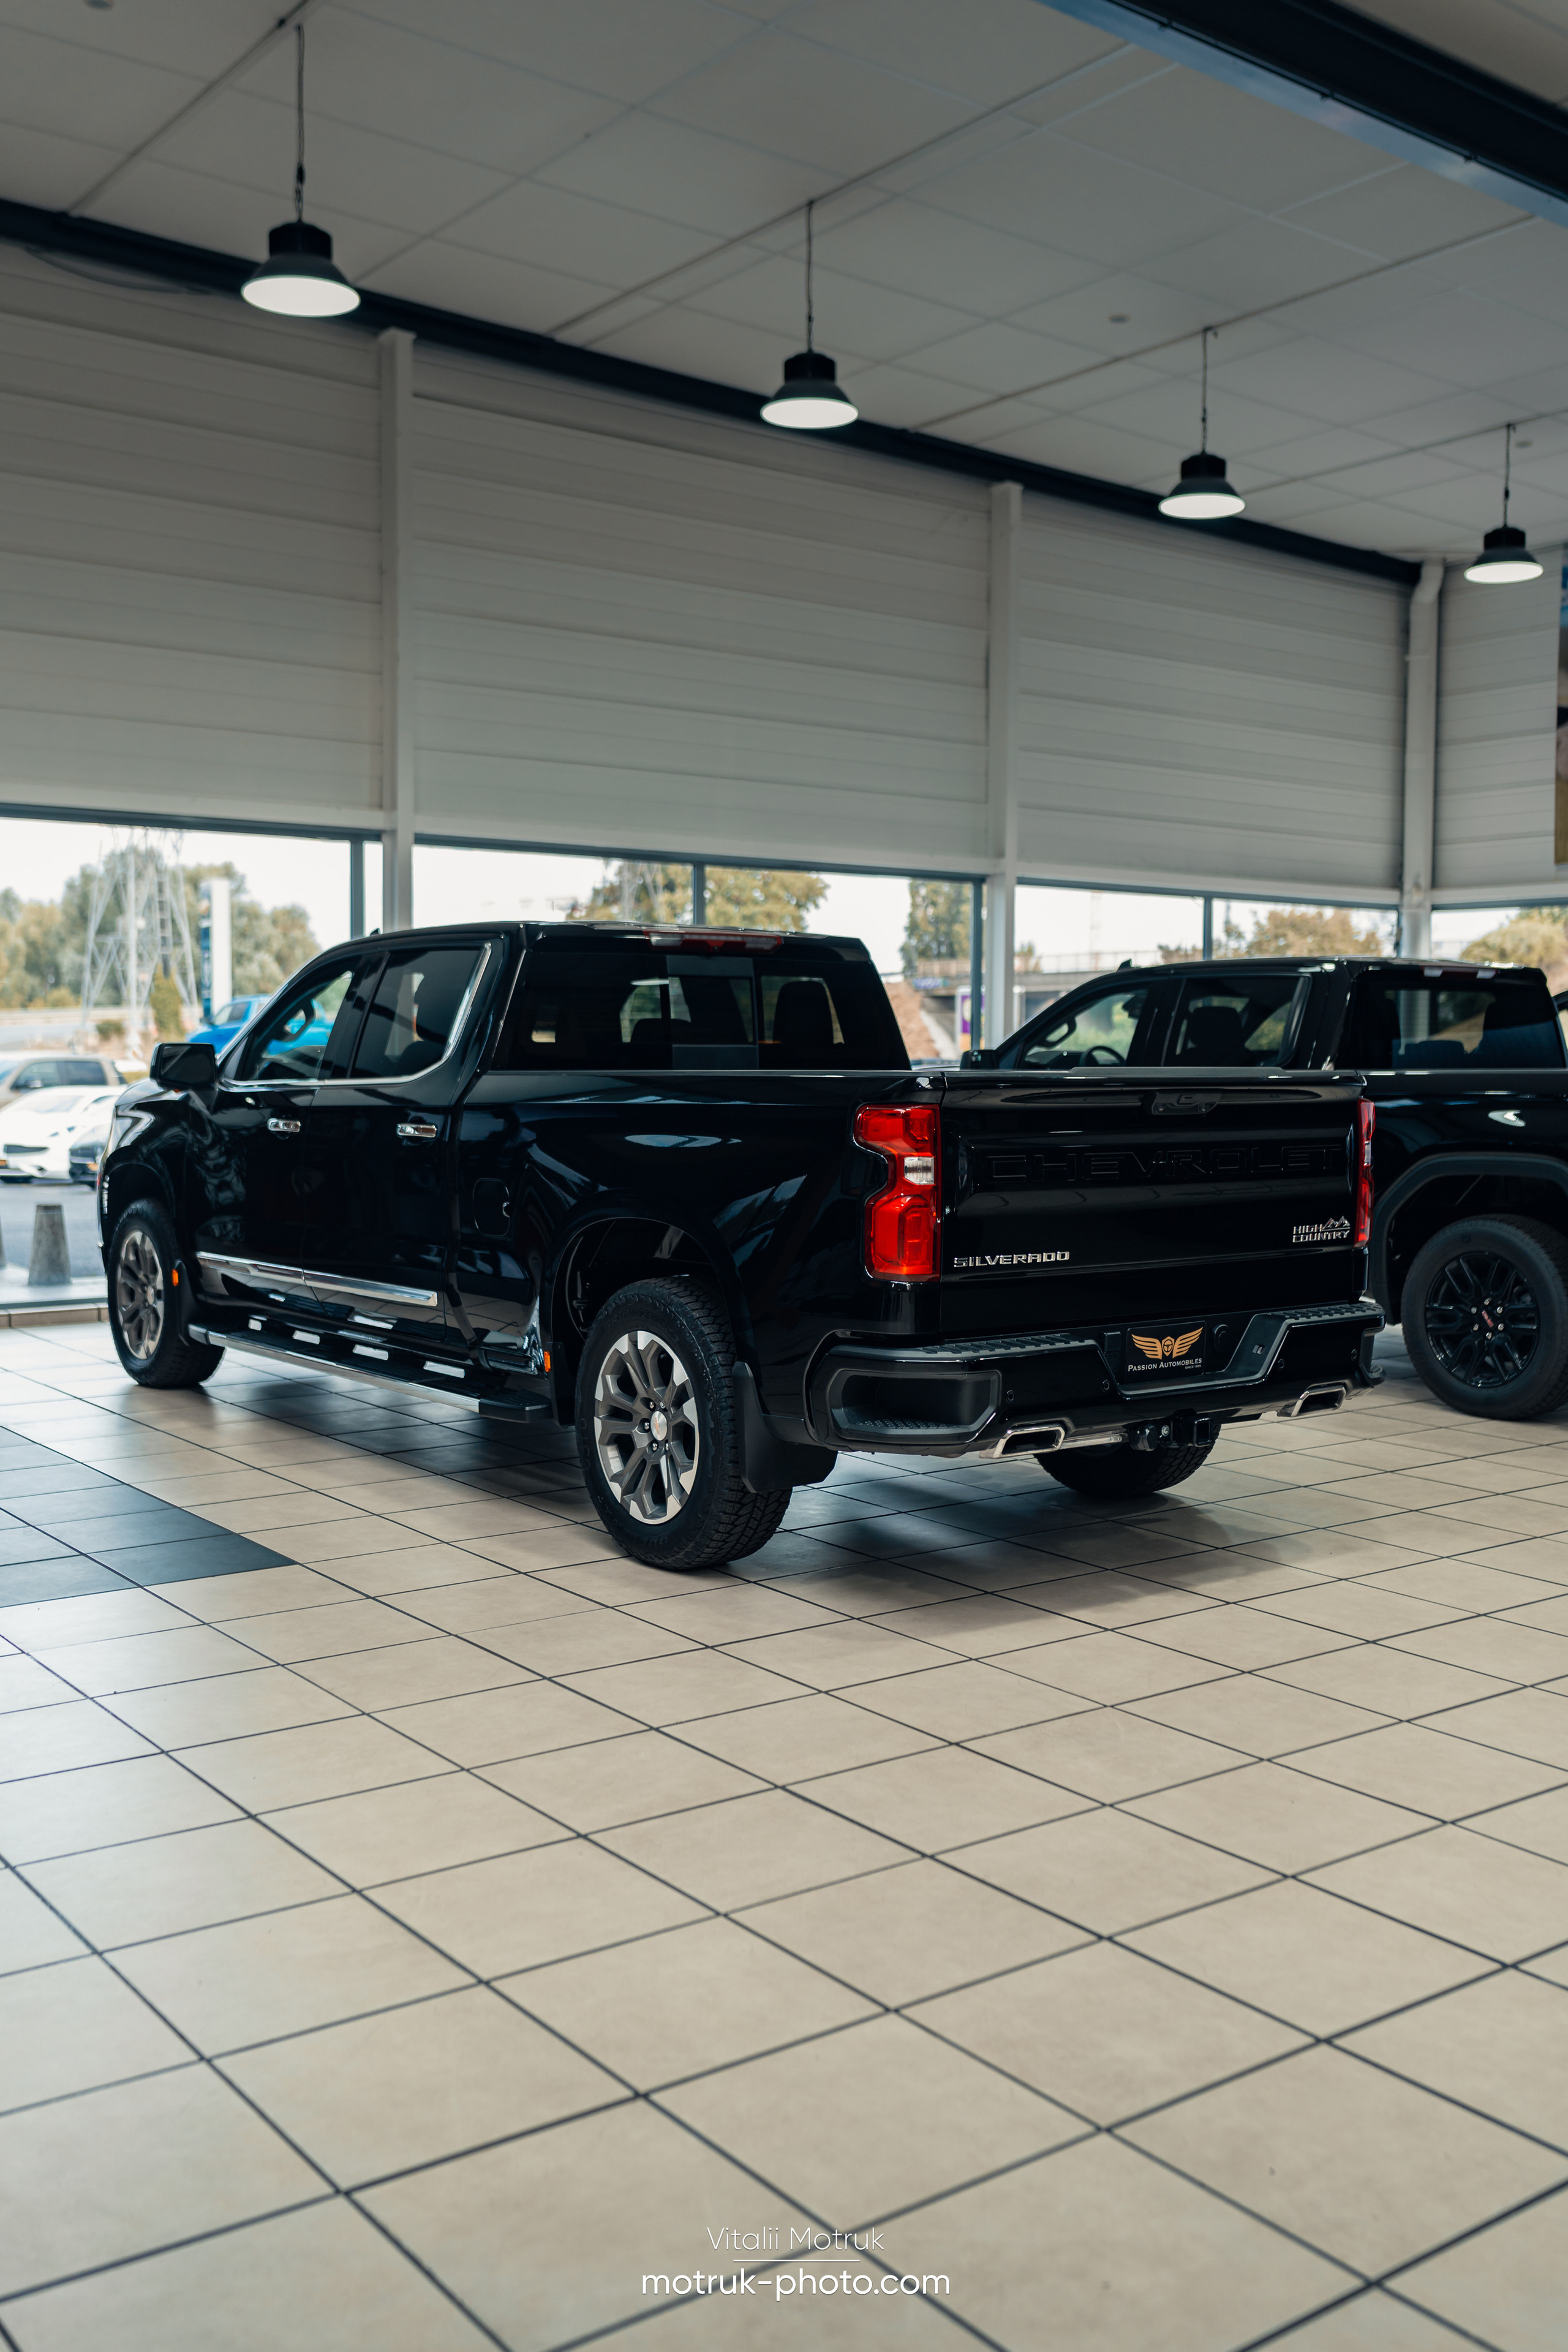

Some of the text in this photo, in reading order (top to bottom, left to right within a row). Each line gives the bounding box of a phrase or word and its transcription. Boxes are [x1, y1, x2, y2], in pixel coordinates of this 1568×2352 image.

[986, 1145, 1341, 1183] CHEVROLET
[1293, 1224, 1323, 1234] HIGH
[1292, 1230, 1350, 1243] COUNTRY
[954, 1251, 1070, 1267] SILVERADO
